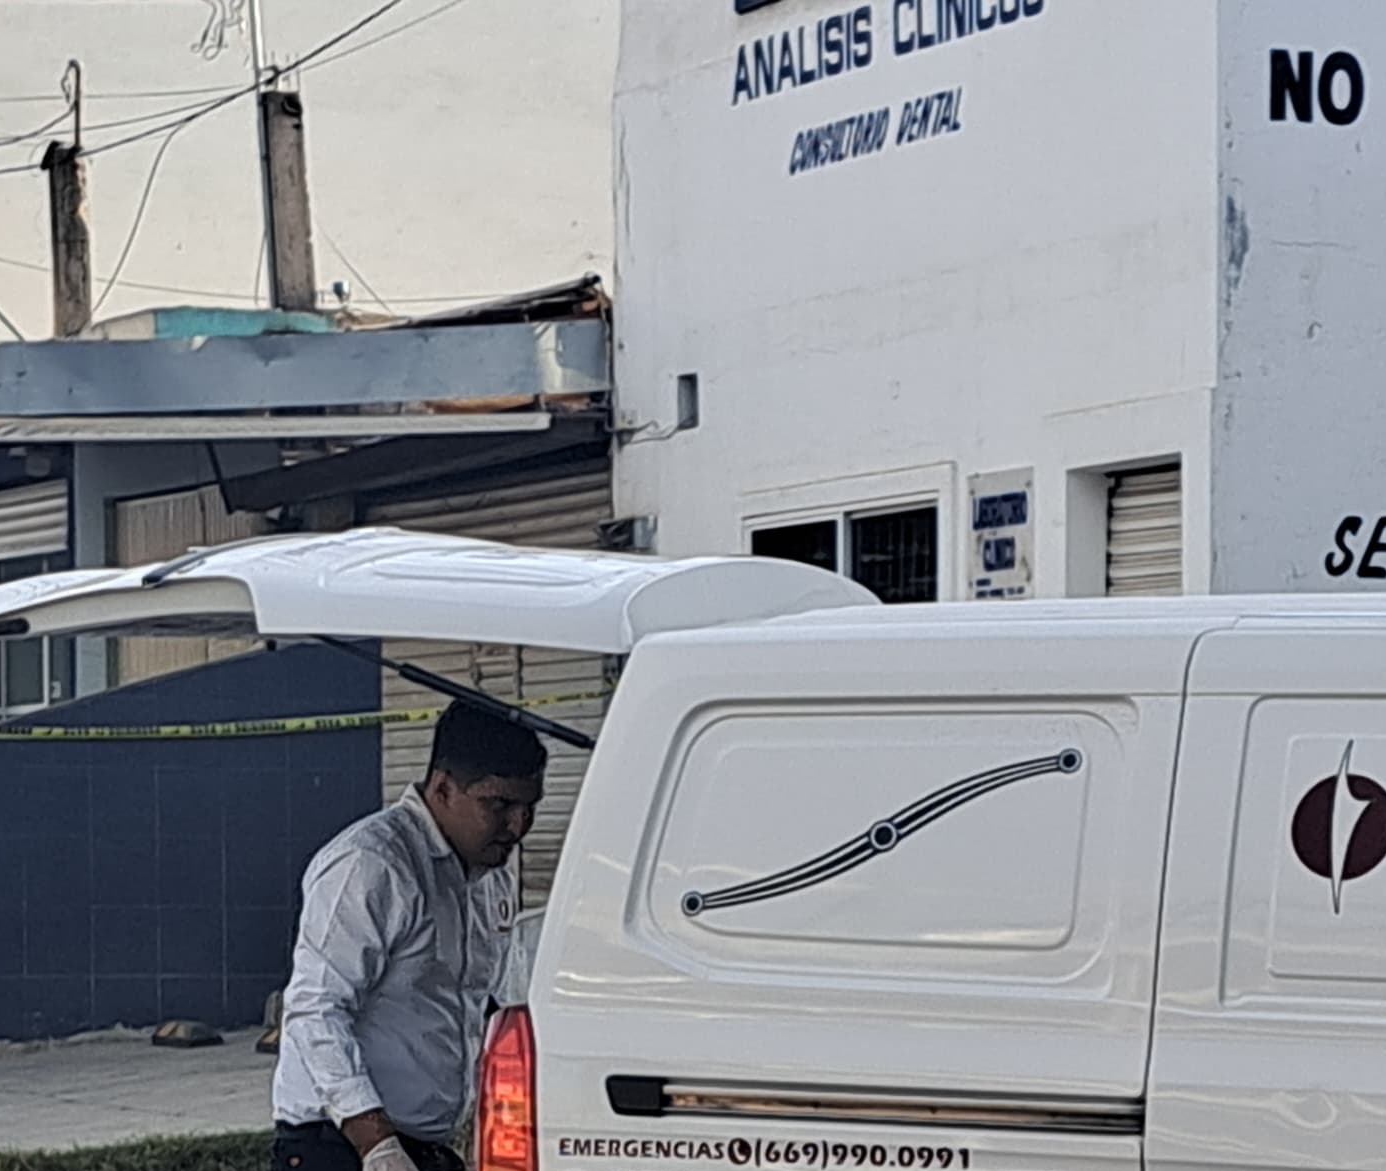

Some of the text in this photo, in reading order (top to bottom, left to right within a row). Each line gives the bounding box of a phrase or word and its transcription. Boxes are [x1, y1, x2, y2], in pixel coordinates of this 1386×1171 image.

[731, 5, 873, 106] ANALISIS
[1269, 48, 1365, 126] NO
[896, 86, 962, 146] DENTAL
[558, 1138, 971, 1170] EMERGENCIAS (669)990.0991
